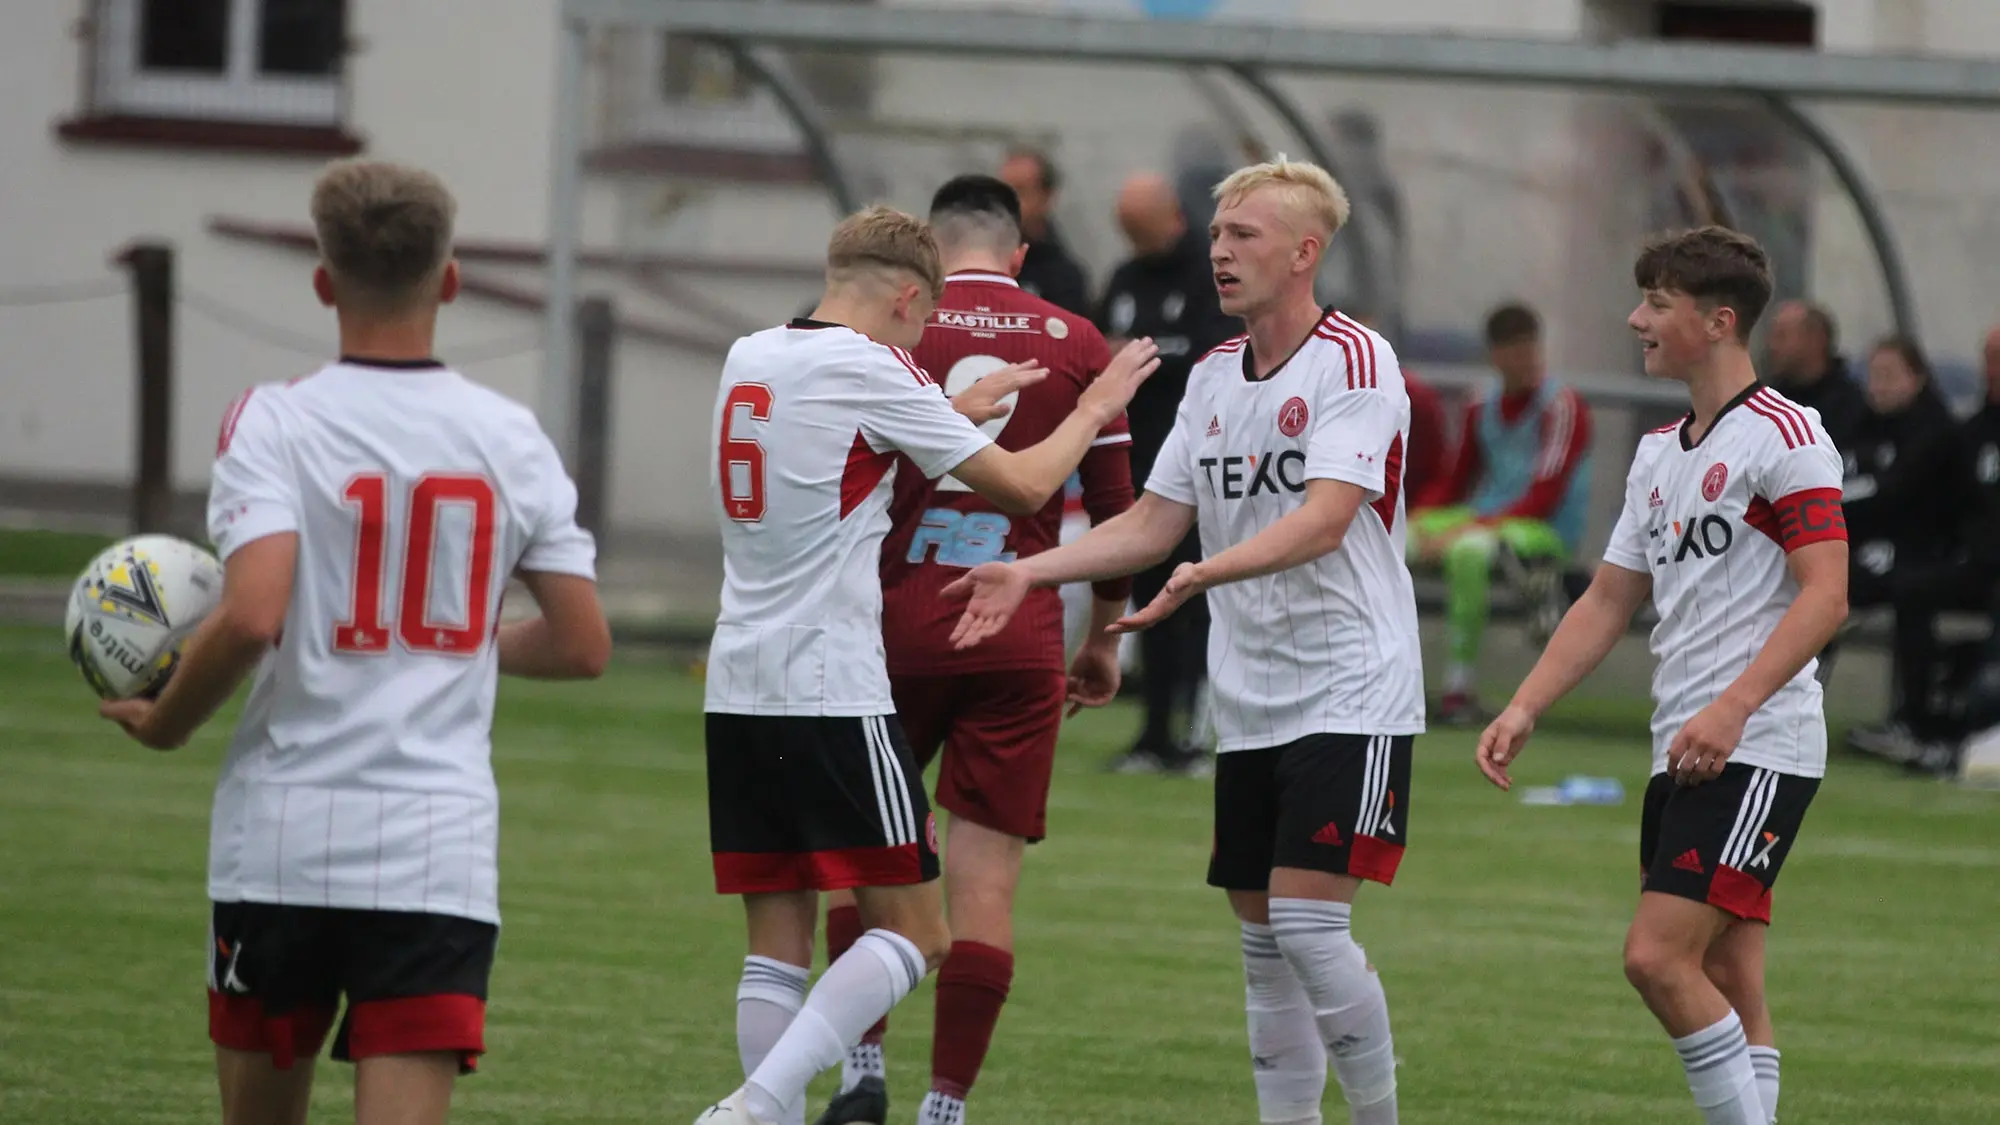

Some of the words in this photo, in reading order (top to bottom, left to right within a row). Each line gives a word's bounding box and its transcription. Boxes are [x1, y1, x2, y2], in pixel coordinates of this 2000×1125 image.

[938, 312, 1030, 329] KASTILLE
[719, 381, 775, 522] 6
[1199, 449, 1306, 500] TEXO
[334, 472, 497, 657] 10
[90, 620, 145, 675] mitre
